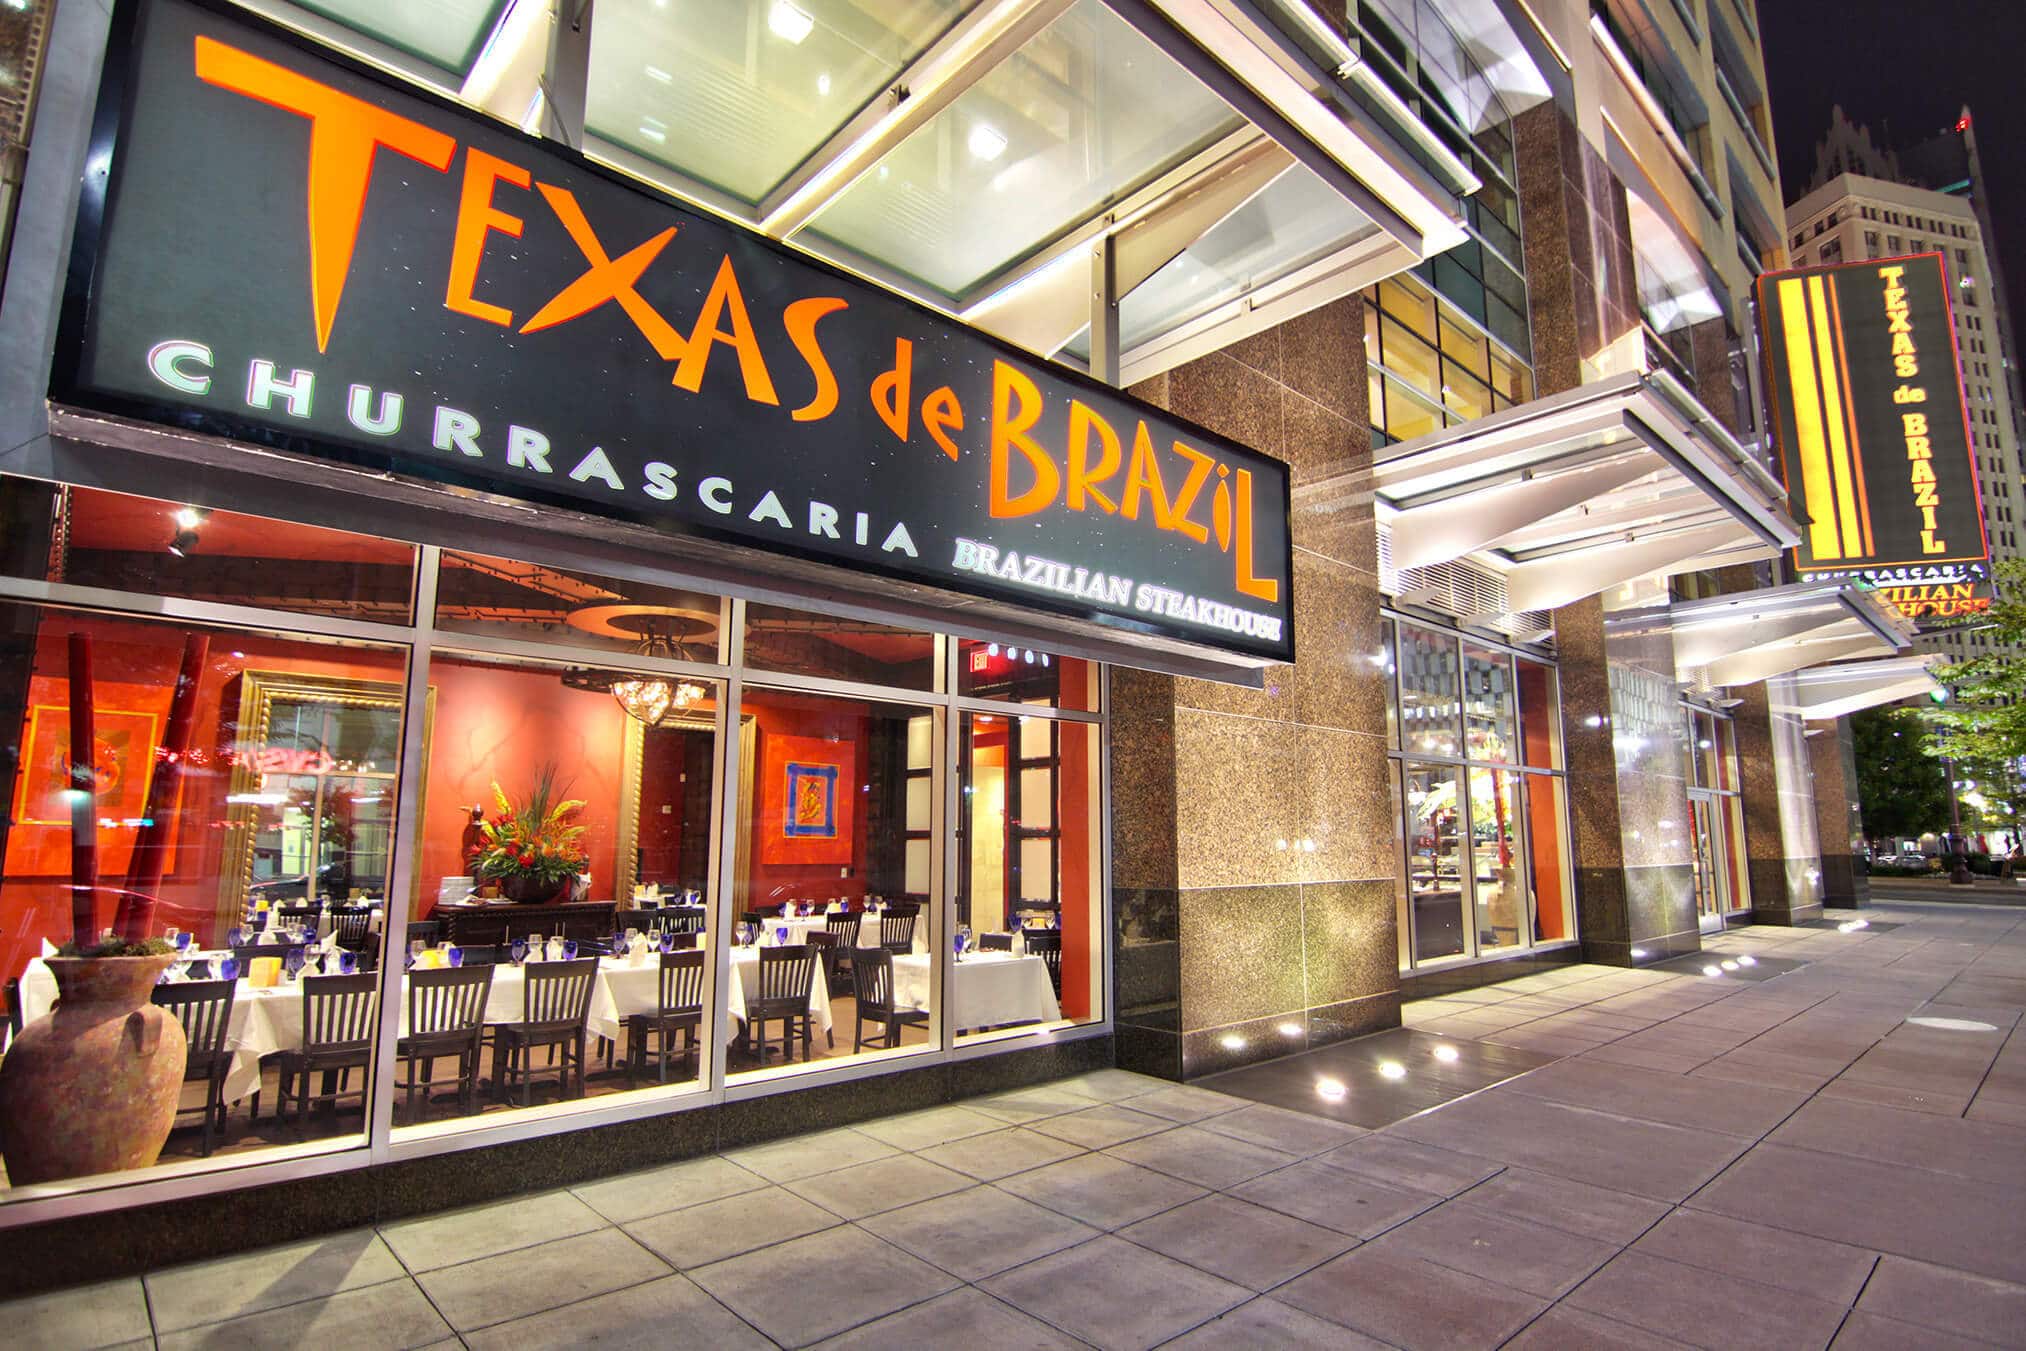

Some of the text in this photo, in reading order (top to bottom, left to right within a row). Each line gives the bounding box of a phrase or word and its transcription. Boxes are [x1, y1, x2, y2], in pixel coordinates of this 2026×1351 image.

[195, 35, 847, 423] TEXAS
[869, 336, 965, 461] de
[146, 339, 920, 558] CHURRASCARIA
[1879, 266, 1945, 554] TEXAS de BRAZIL
[952, 536, 1283, 642] BRAZILIAN STEAKHOUSE
